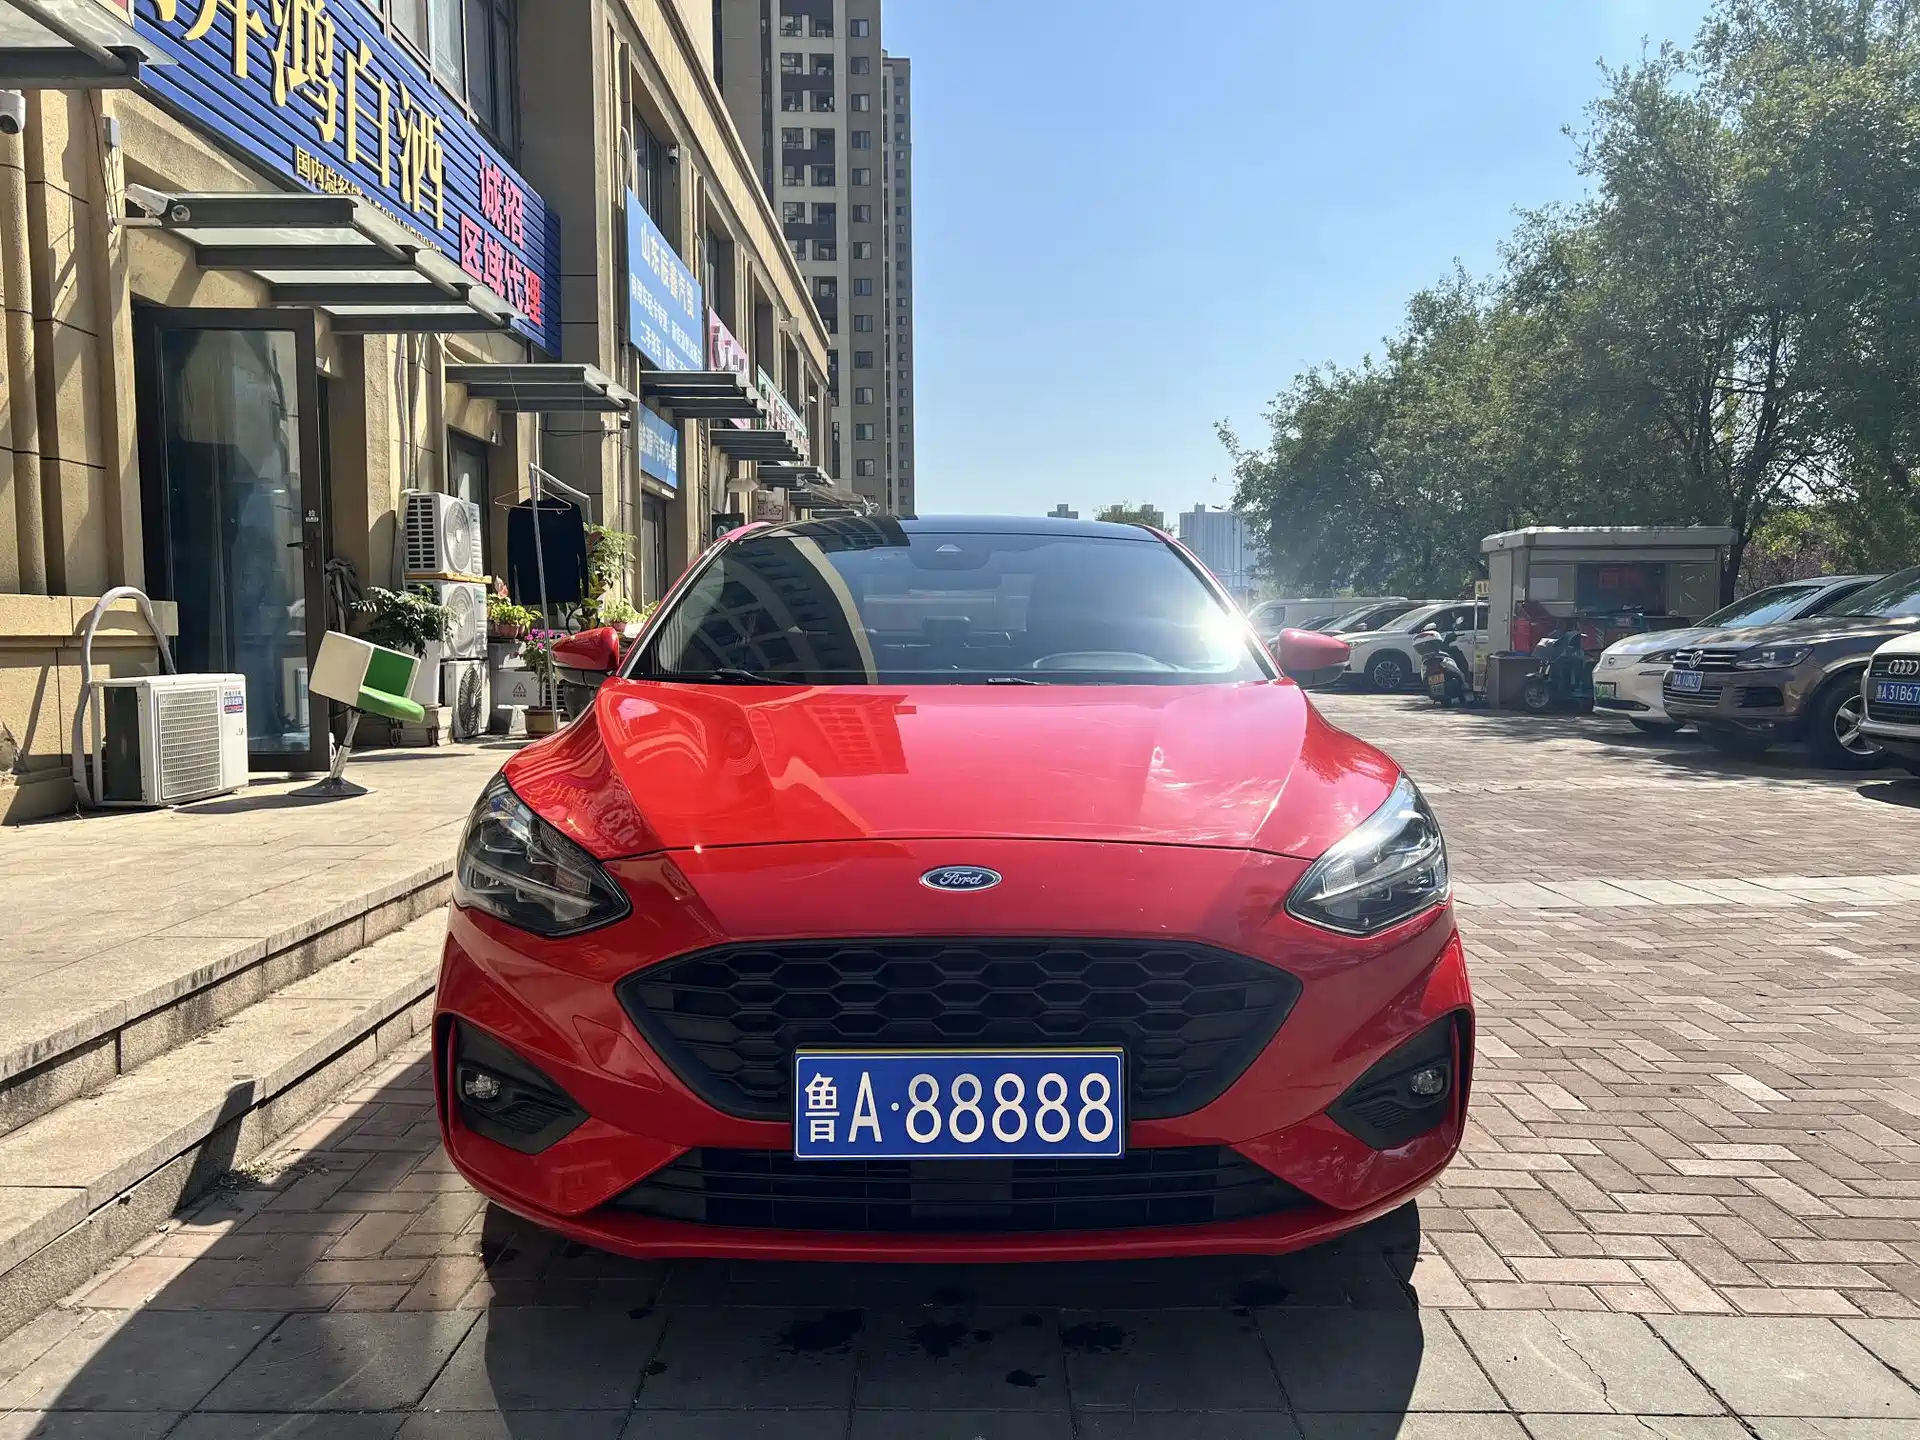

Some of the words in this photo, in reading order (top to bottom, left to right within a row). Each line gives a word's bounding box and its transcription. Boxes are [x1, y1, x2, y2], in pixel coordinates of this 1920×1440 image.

[152, 0, 444, 231] 鸿白酒
[295, 145, 363, 195] 国内总经
[480, 152, 524, 250] 诚招
[460, 213, 542, 328] 区域代理
[940, 871, 983, 886] Ford
[804, 1071, 1114, 1144] 鲁A·88888
